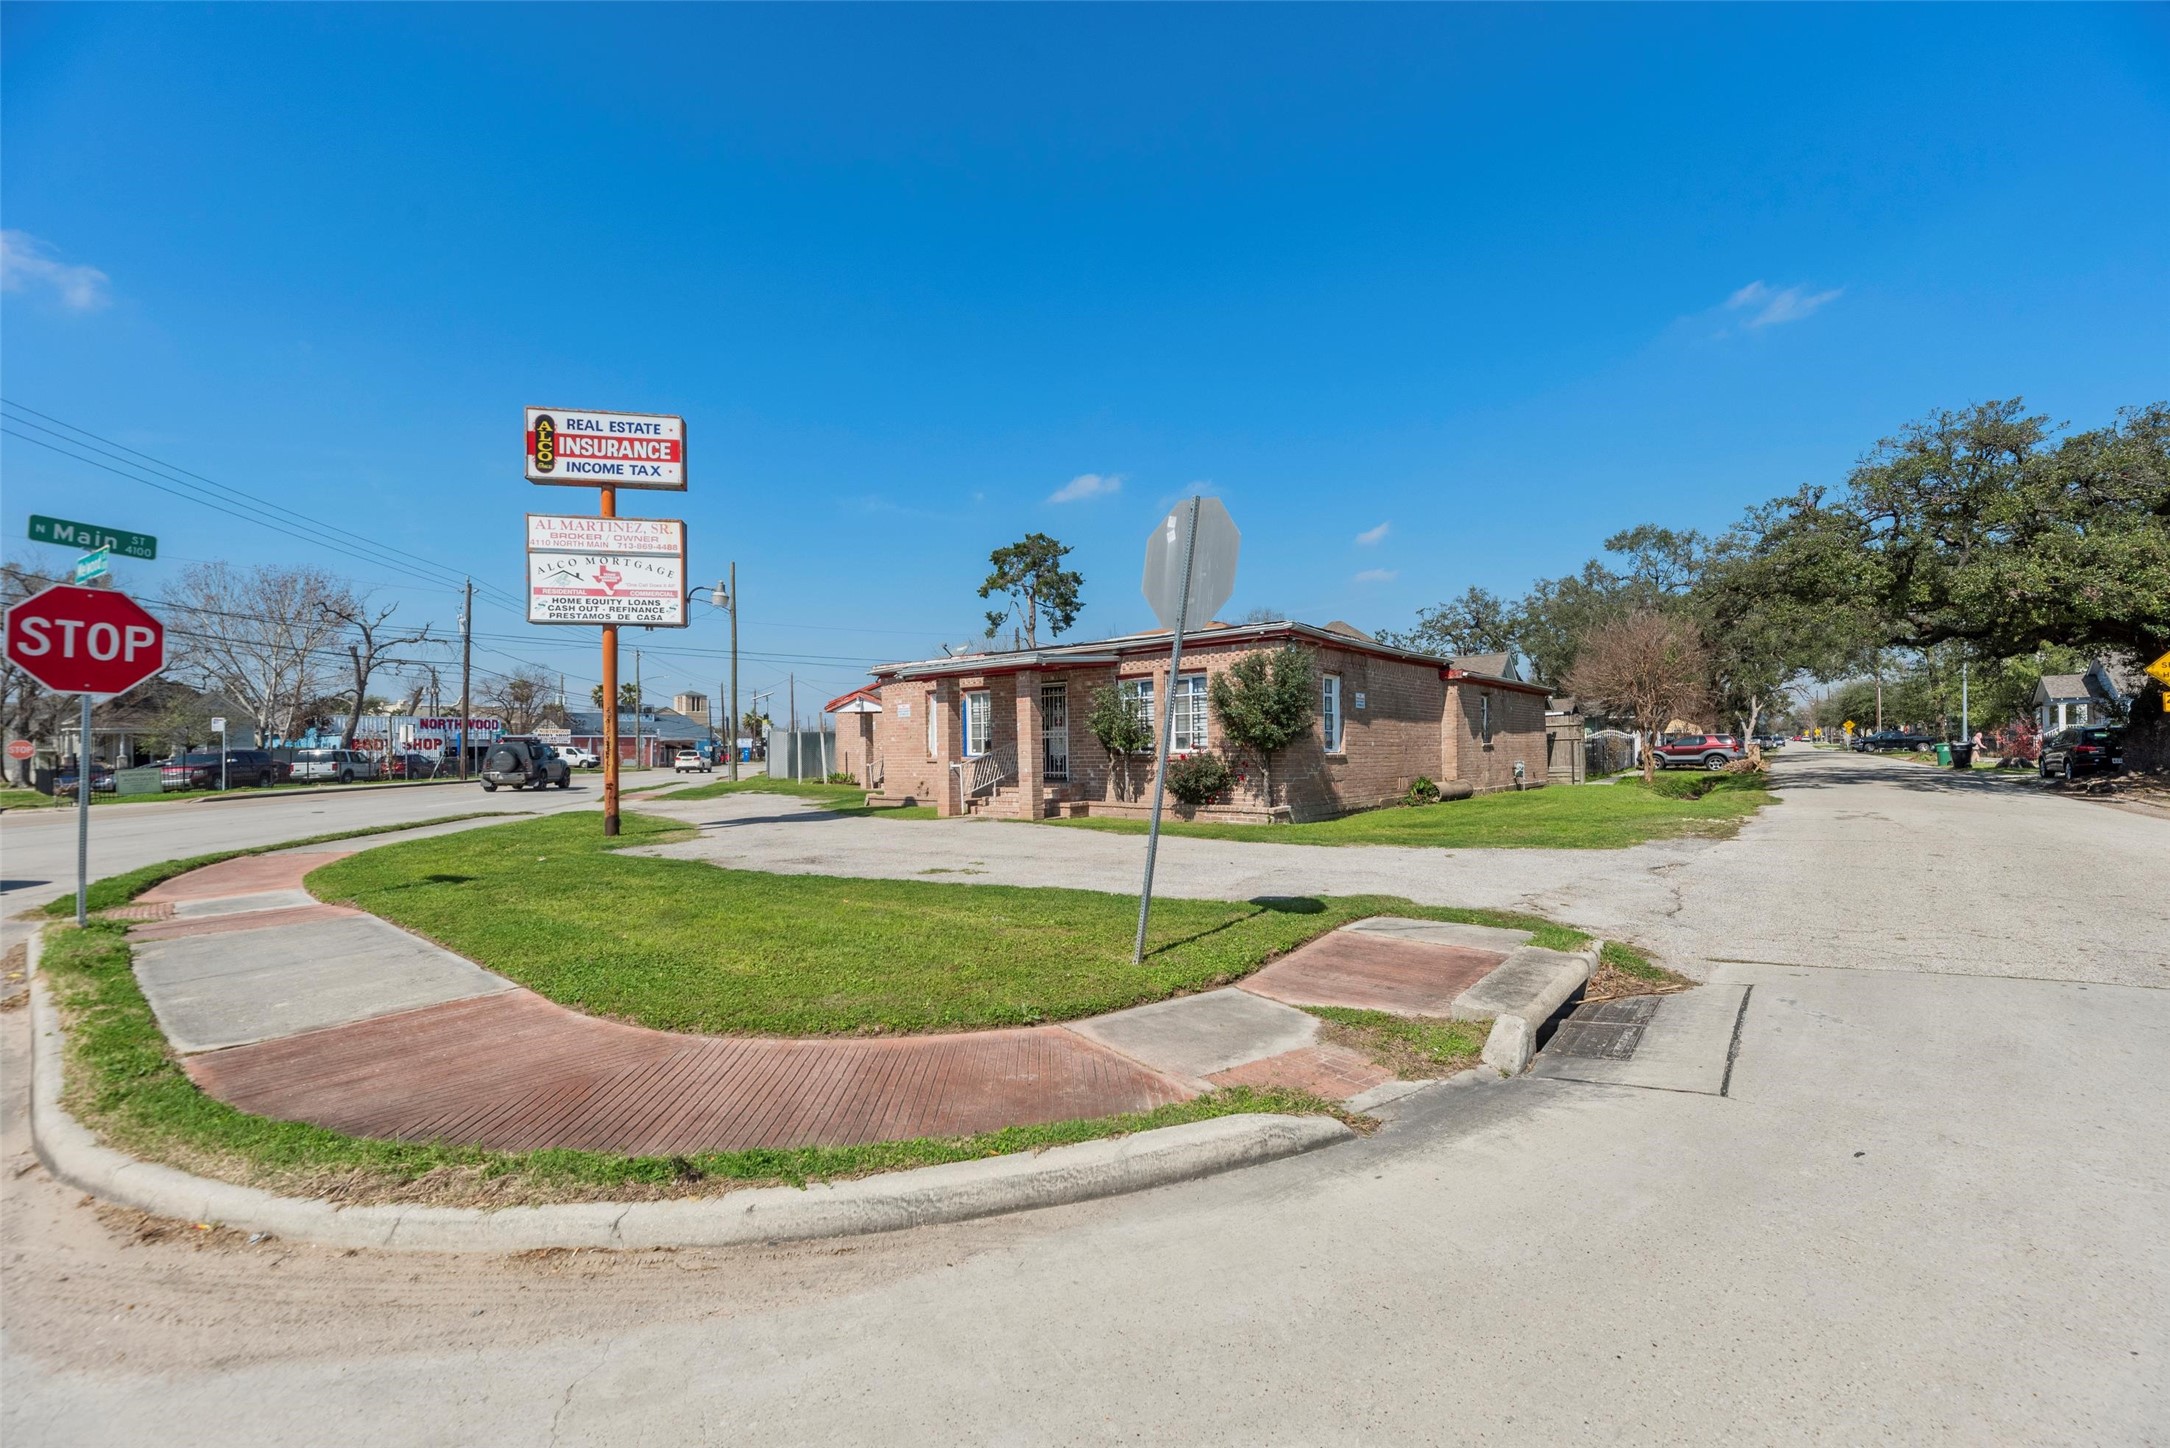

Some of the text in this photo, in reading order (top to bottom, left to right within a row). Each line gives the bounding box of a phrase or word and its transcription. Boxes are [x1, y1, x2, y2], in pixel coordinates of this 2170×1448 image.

[567, 418, 661, 435] REAL ESTATE
[537, 420, 553, 462] ALCO
[559, 436, 671, 460] INSURANCE
[566, 461, 624, 475] INCOME
[630, 464, 662, 477] TAX
[535, 519, 673, 535] AL MARTINEZ, SR.
[35, 523, 146, 550] N Main ST
[550, 532, 602, 541] BROKER
[614, 534, 660, 543] OWNER
[530, 539, 550, 547] 4110
[553, 539, 584, 548] NORTH
[587, 541, 609, 549] MAIN
[124, 545, 152, 558] 4100
[537, 557, 578, 575] ALCO
[585, 556, 675, 579] MORTGAGE
[542, 588, 587, 596] RESIDENTIAL
[630, 590, 675, 598] COMMERCIAL
[552, 597, 661, 607] HOME EQUITY LOANS
[547, 604, 576, 612] CASH
[609, 606, 665, 614] REFINANCE
[549, 612, 611, 620] PRESTAMOS
[617, 613, 631, 621] DE
[16, 615, 156, 663] STOP
[8, 745, 34, 754] STOP
